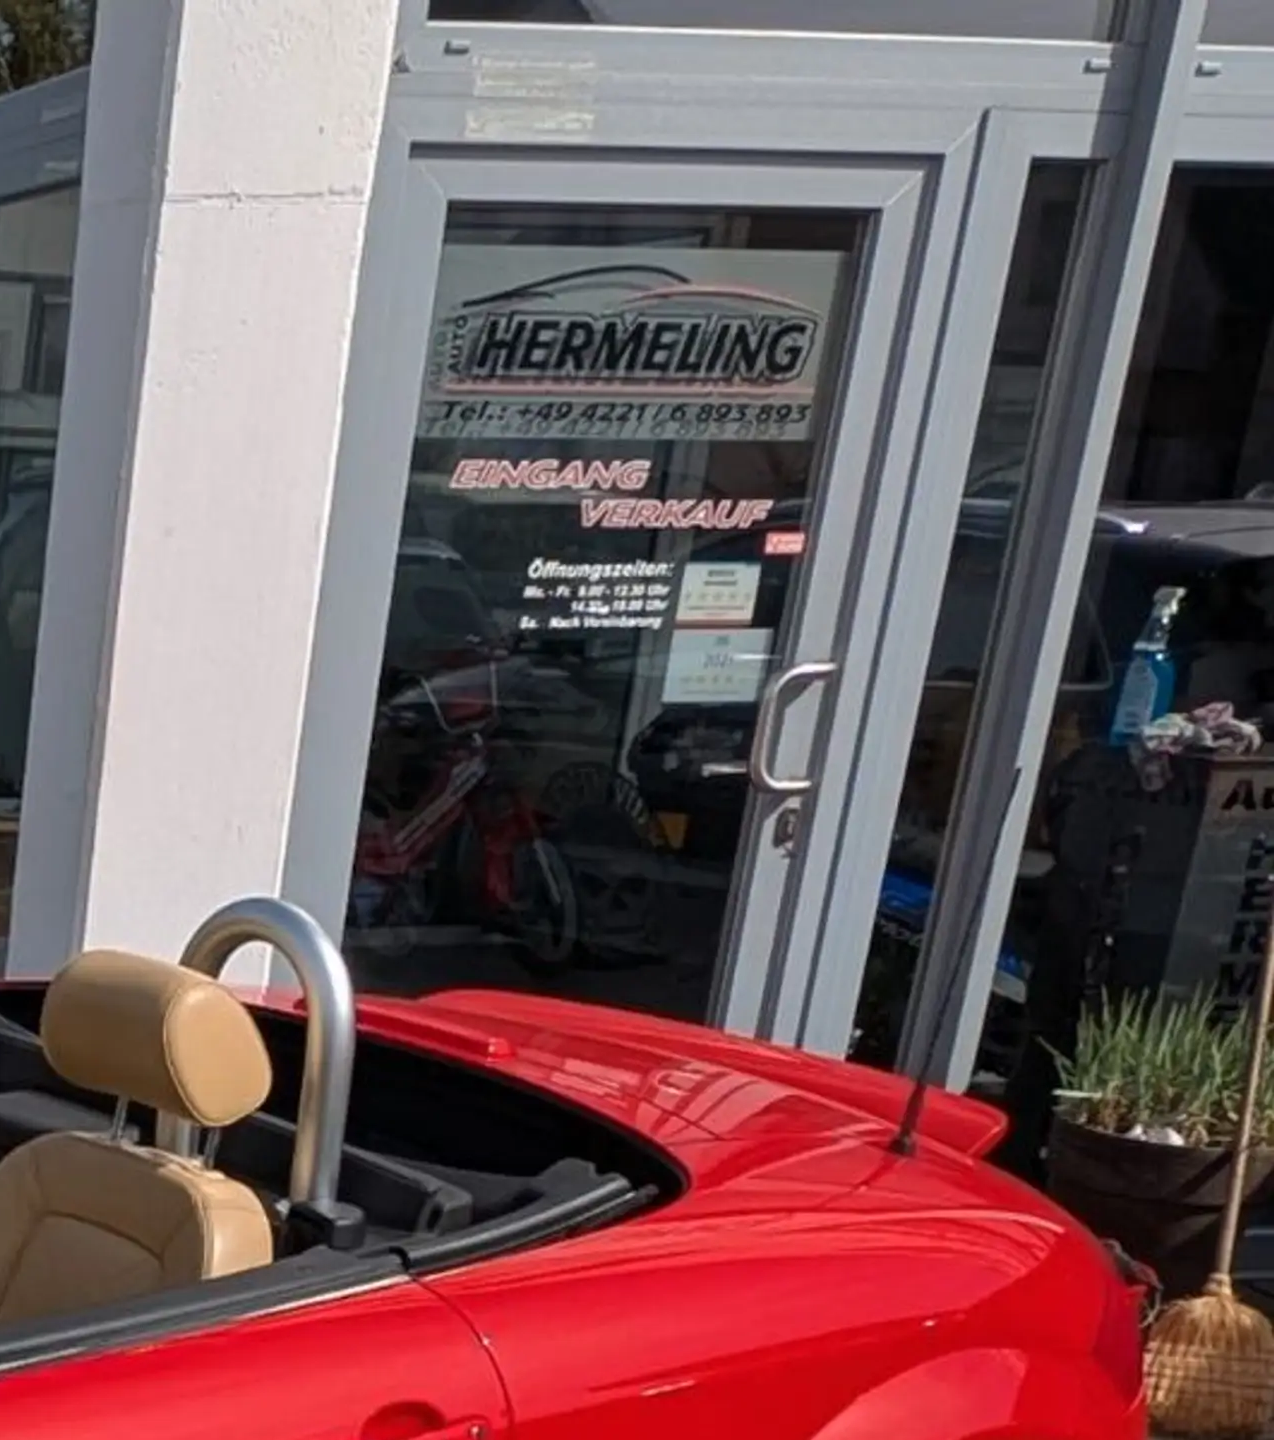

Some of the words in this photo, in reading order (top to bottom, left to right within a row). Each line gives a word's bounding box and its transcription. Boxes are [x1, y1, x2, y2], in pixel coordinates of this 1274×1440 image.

[447, 314, 469, 376] AUTO
[477, 319, 809, 375] HERMELING
[517, 401, 573, 422] +49
[580, 401, 645, 423] 4221
[670, 403, 688, 422] 6
[696, 403, 747, 424] 893
[755, 403, 812, 424] 893
[450, 458, 651, 490] EINGANG
[580, 499, 774, 529] VERKAUF
[527, 556, 676, 582] Öffnungszeiten:
